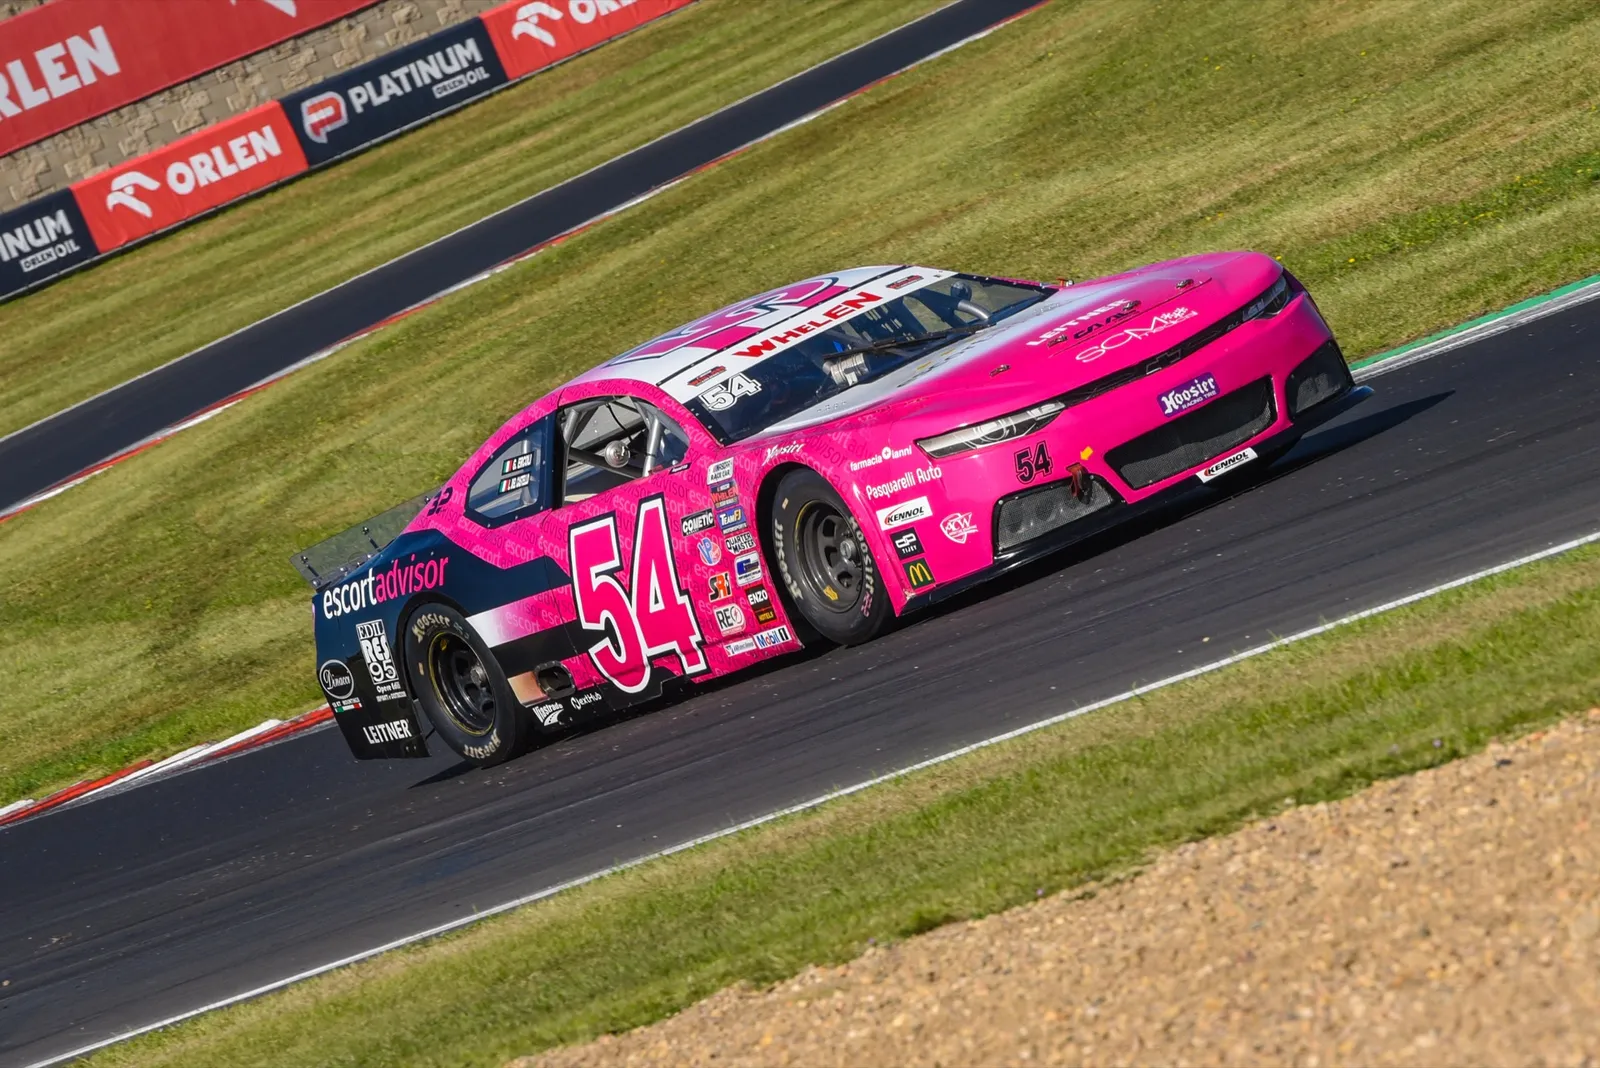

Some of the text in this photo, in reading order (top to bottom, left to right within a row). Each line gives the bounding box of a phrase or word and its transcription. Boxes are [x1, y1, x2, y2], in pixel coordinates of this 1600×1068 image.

[347, 37, 483, 114] PLATINUM
[466, 66, 491, 85] OIL
[166, 124, 282, 195] ORLEN
[54, 238, 81, 258] OIL
[731, 291, 884, 358] WHELEN
[698, 372, 762, 411] 54
[1161, 377, 1216, 415] Hoosier
[1181, 396, 1203, 410] RACING
[850, 454, 883, 472] farmacia
[1014, 440, 1053, 484] 54
[1207, 451, 1248, 474] KENNOL
[711, 486, 739, 503] WHELEN
[865, 466, 942, 500] Pasquarelli Auto
[682, 512, 714, 533] COMETIC
[887, 506, 925, 523] KENNOL
[725, 532, 751, 550] QUARTER
[732, 540, 754, 554] MASTER
[323, 554, 449, 619] escortadvisor
[568, 492, 711, 694] 54
[748, 589, 768, 605] ENZO
[357, 622, 384, 639] EDIL
[756, 629, 780, 648] Mobil
[778, 627, 789, 641] 1
[360, 635, 391, 663] RES
[368, 659, 397, 682] 95
[363, 719, 412, 744] LEITNER
